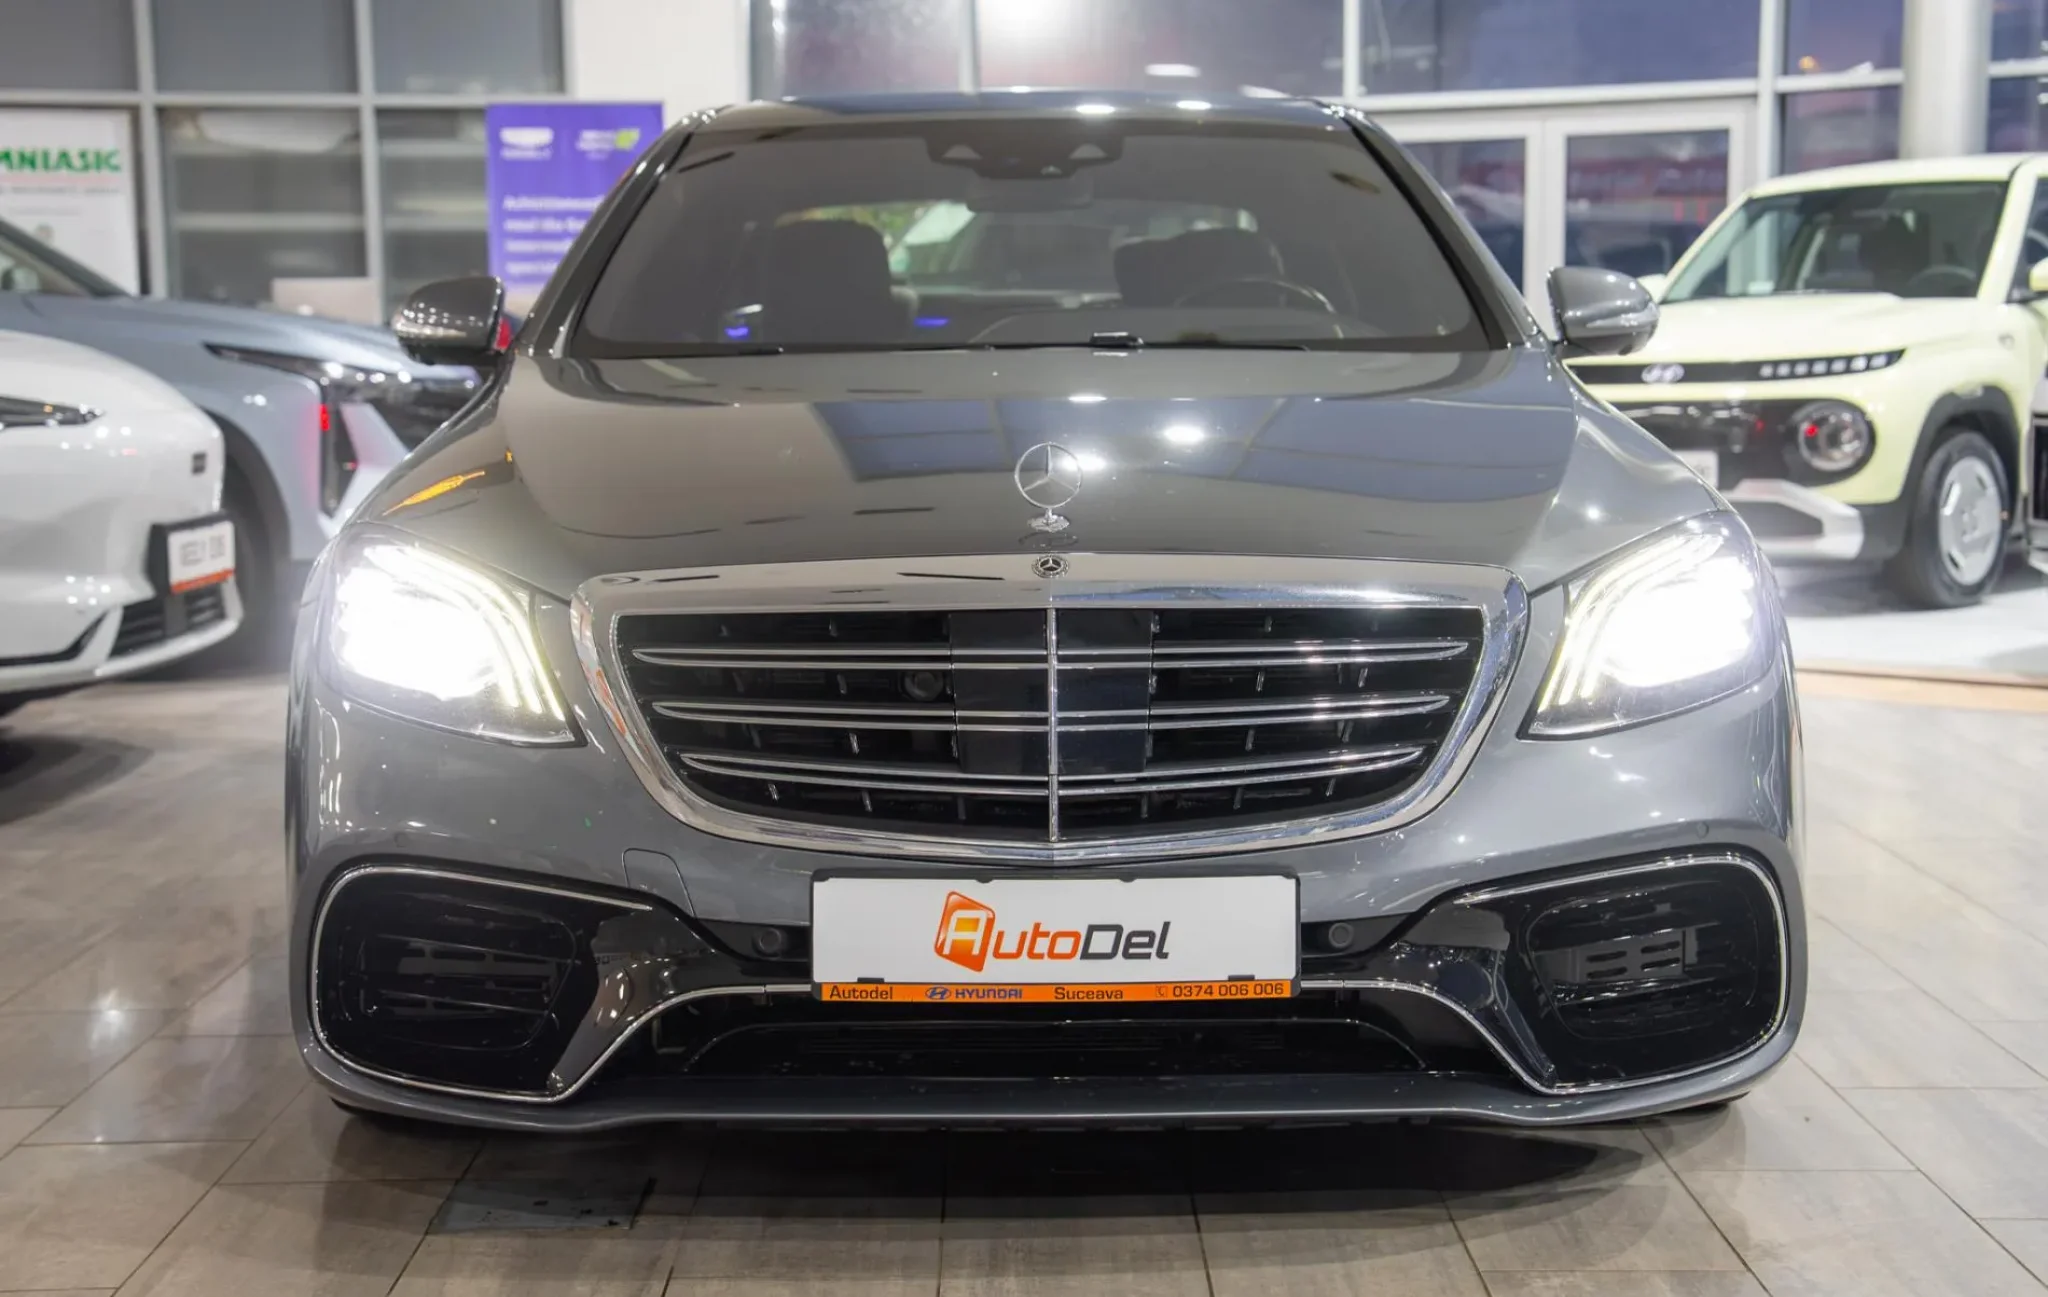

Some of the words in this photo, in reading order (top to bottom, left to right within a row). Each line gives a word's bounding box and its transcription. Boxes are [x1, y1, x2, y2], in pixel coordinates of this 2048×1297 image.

[942, 908, 1171, 961] AutoDel
[829, 985, 893, 1000] Autodel
[955, 988, 1023, 999] HYUNDAI
[1054, 986, 1123, 1000] Suceava
[1172, 984, 1214, 997] 0374
[1218, 984, 1249, 996] 006
[1253, 982, 1284, 995] 006
